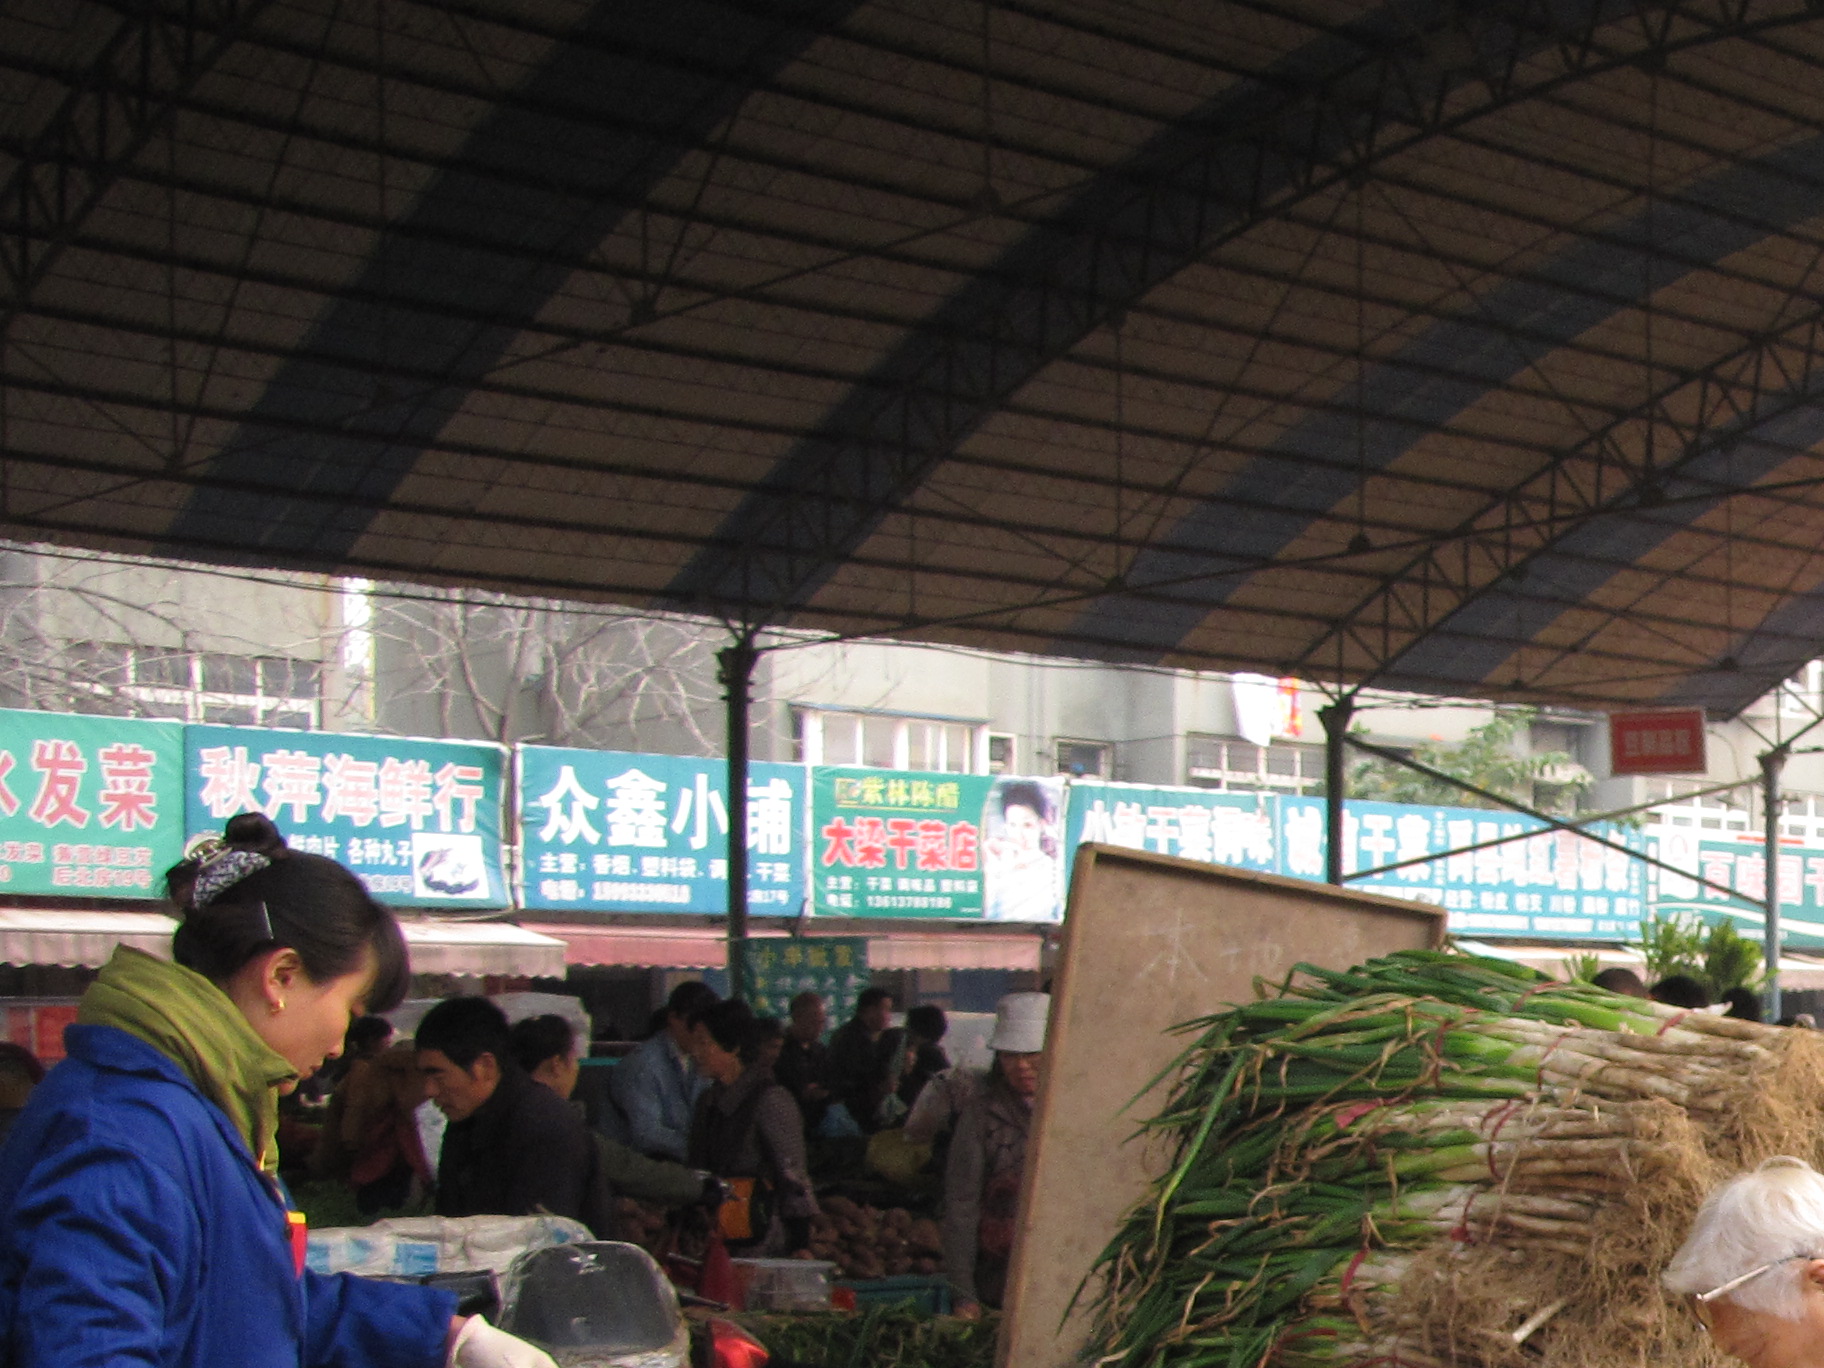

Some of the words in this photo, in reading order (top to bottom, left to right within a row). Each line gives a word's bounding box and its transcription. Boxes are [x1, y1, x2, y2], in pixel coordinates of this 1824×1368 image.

[200, 746, 484, 832] 秋萍海鲜行
[539, 765, 792, 855] 众鑫小铺
